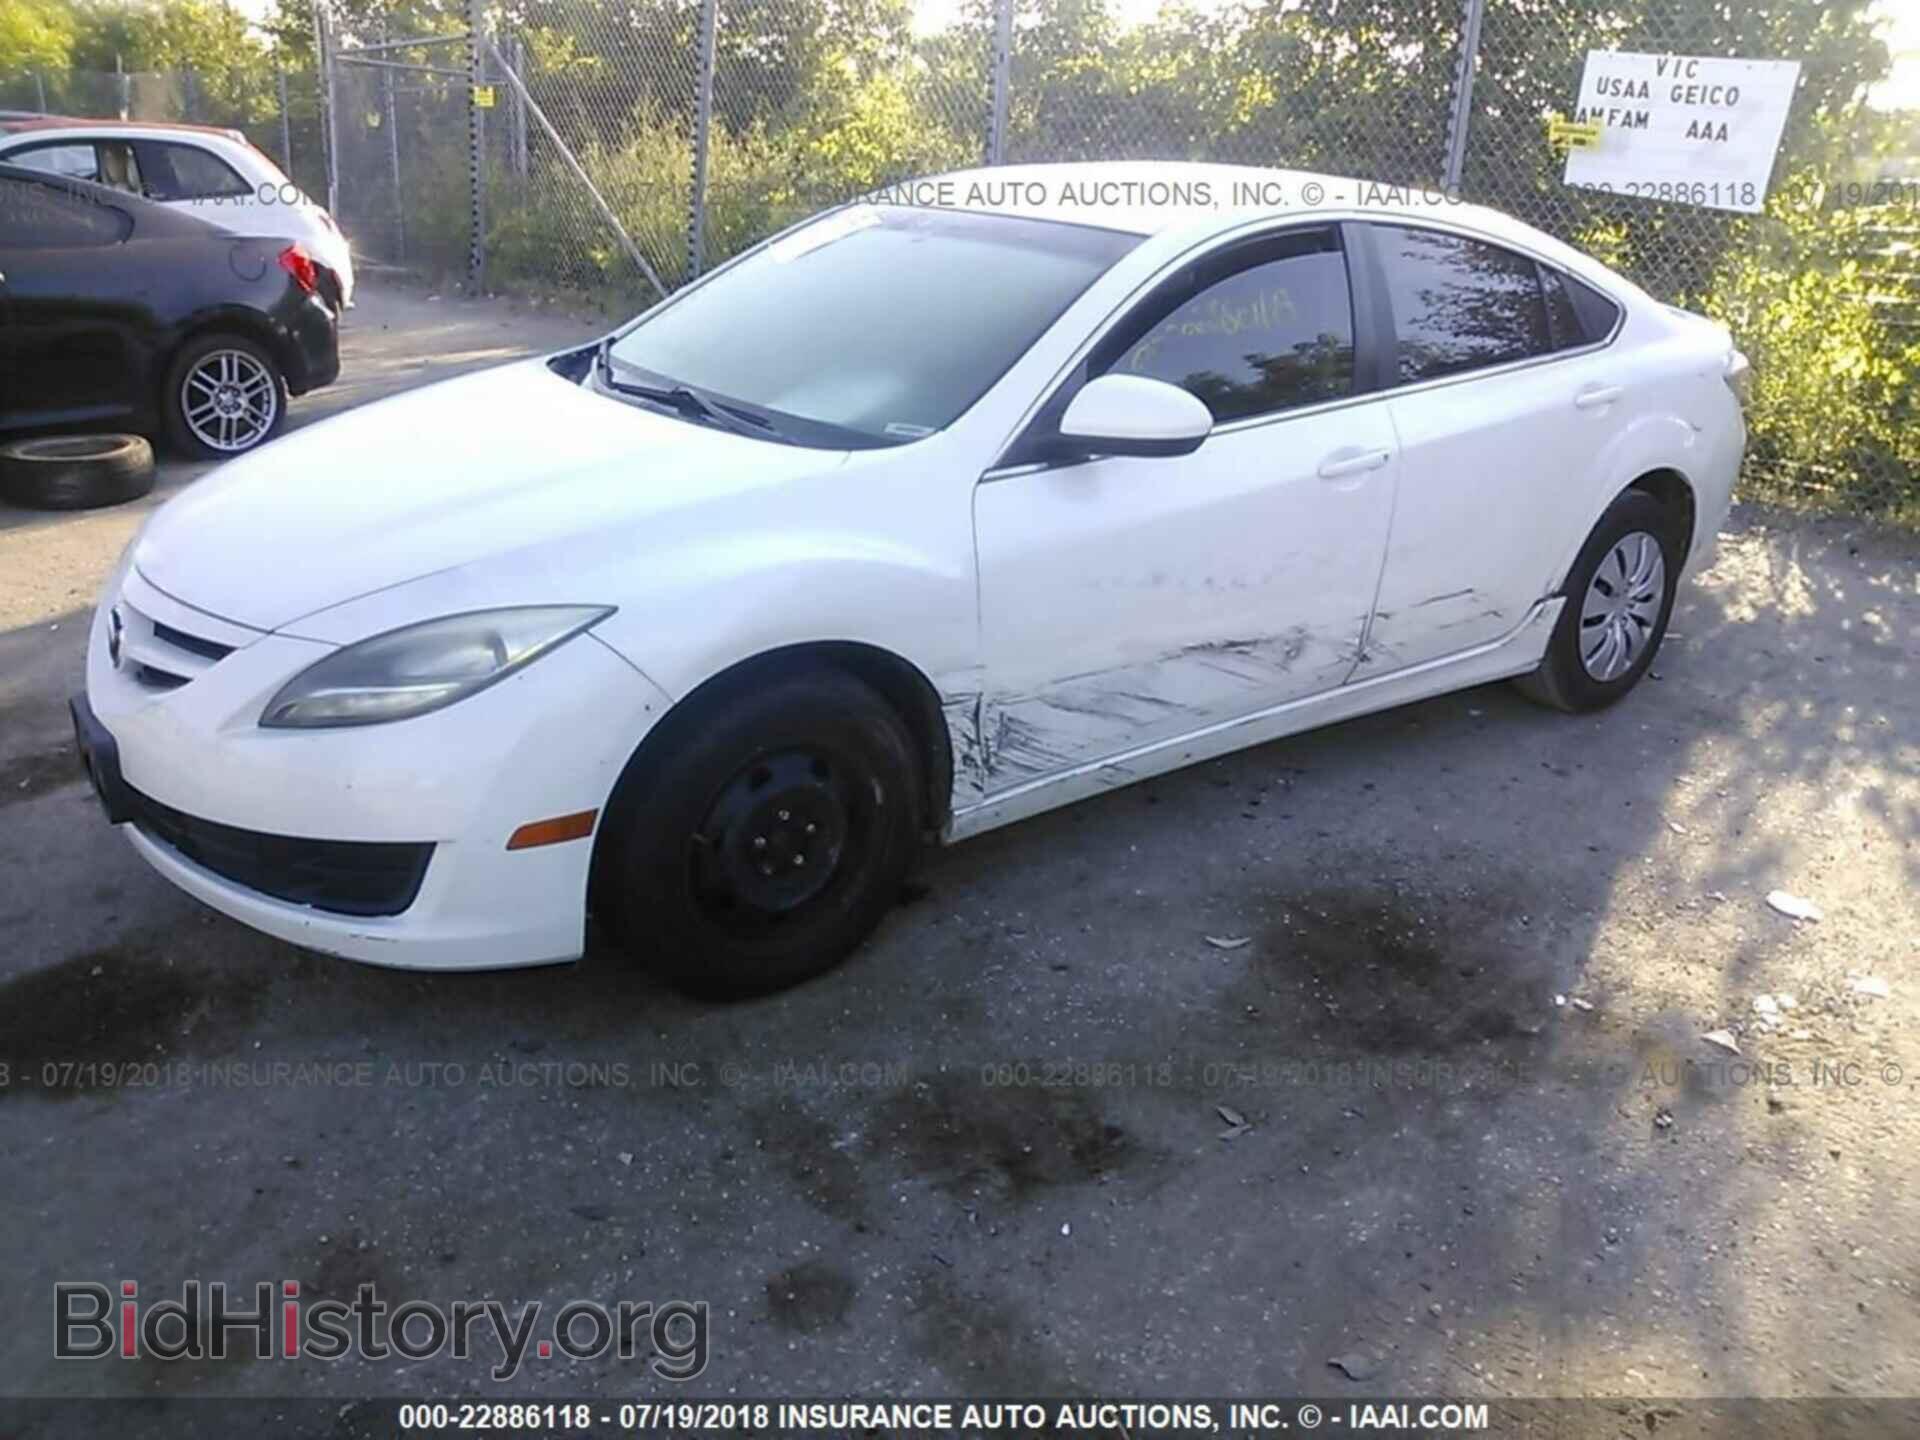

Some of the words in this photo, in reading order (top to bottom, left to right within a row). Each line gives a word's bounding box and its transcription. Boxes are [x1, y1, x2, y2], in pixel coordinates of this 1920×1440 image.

[1657, 58, 1699, 79] VIC
[1597, 77, 1650, 99] USAA
[1670, 84, 1740, 107] GEICO
[1685, 120, 1728, 142] AAA
